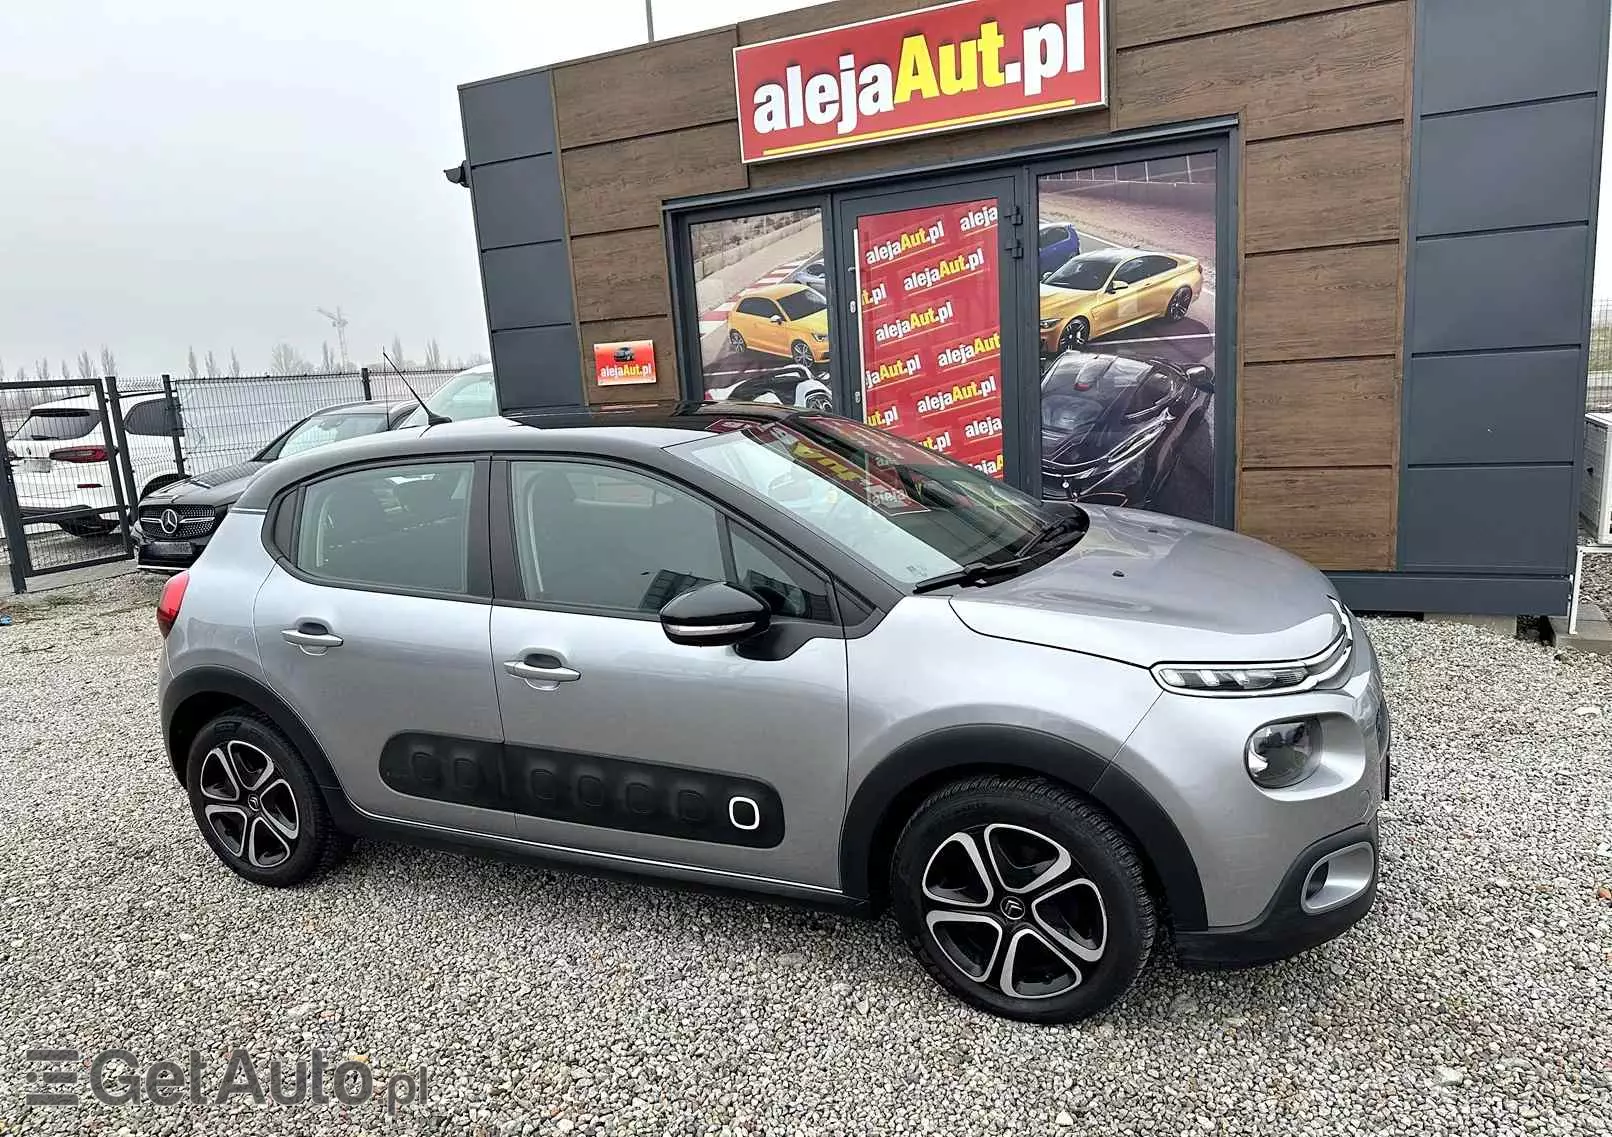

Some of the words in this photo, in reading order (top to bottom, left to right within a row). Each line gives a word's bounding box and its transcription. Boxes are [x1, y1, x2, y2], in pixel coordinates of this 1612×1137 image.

[753, 2, 1085, 134] alejaAut.pl
[866, 220, 945, 265] alejaAut.pl
[904, 248, 984, 291] alejaAut.pl
[876, 302, 954, 341] alejaAut.pl
[600, 363, 652, 377] alejaAut.pl
[917, 376, 996, 413] alejaAut.pl
